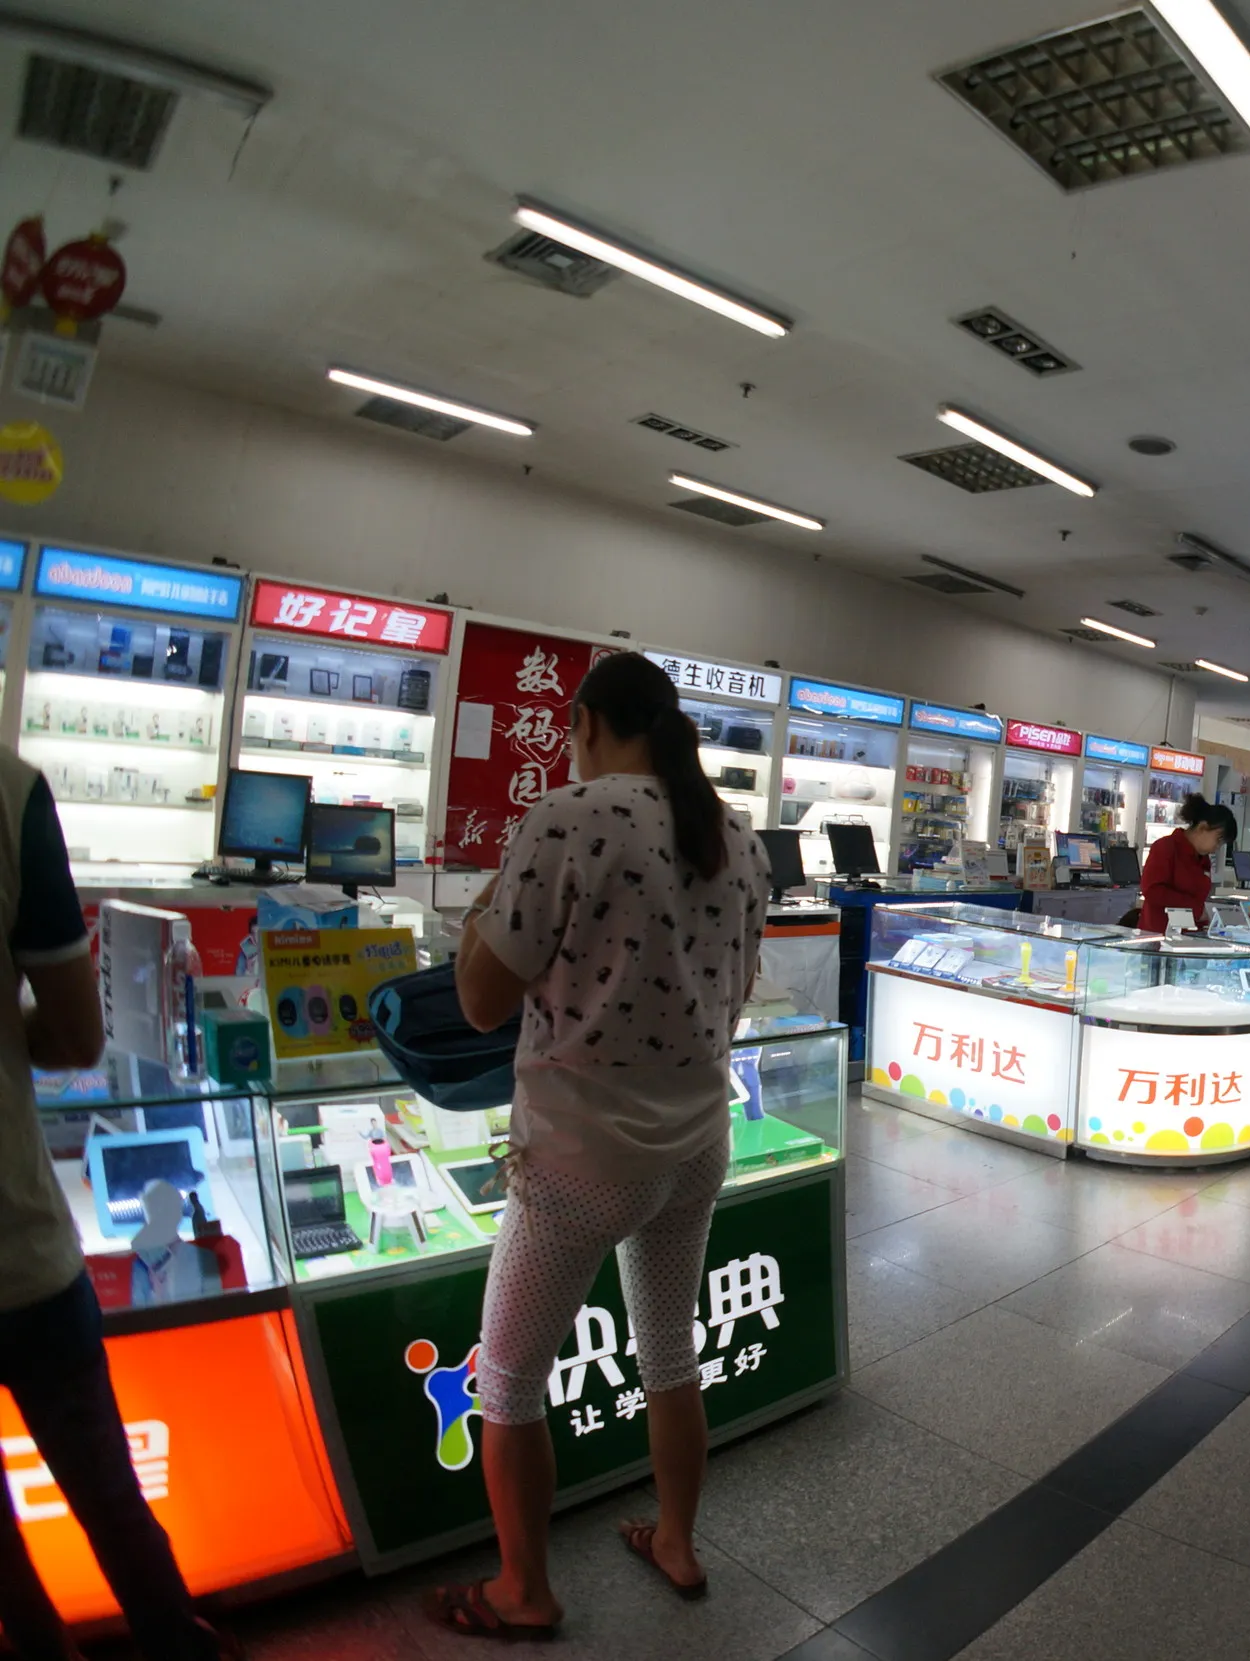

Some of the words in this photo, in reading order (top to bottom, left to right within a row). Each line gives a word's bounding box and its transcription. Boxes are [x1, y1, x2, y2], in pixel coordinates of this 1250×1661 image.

[273, 592, 427, 644] 好记星
[662, 658, 766, 698] 德生收音机
[911, 1022, 1025, 1085] 万利达
[1118, 1069, 1242, 1106] 万利达
[548, 1252, 785, 1407] 快典
[570, 1342, 768, 1437] 让学更好
